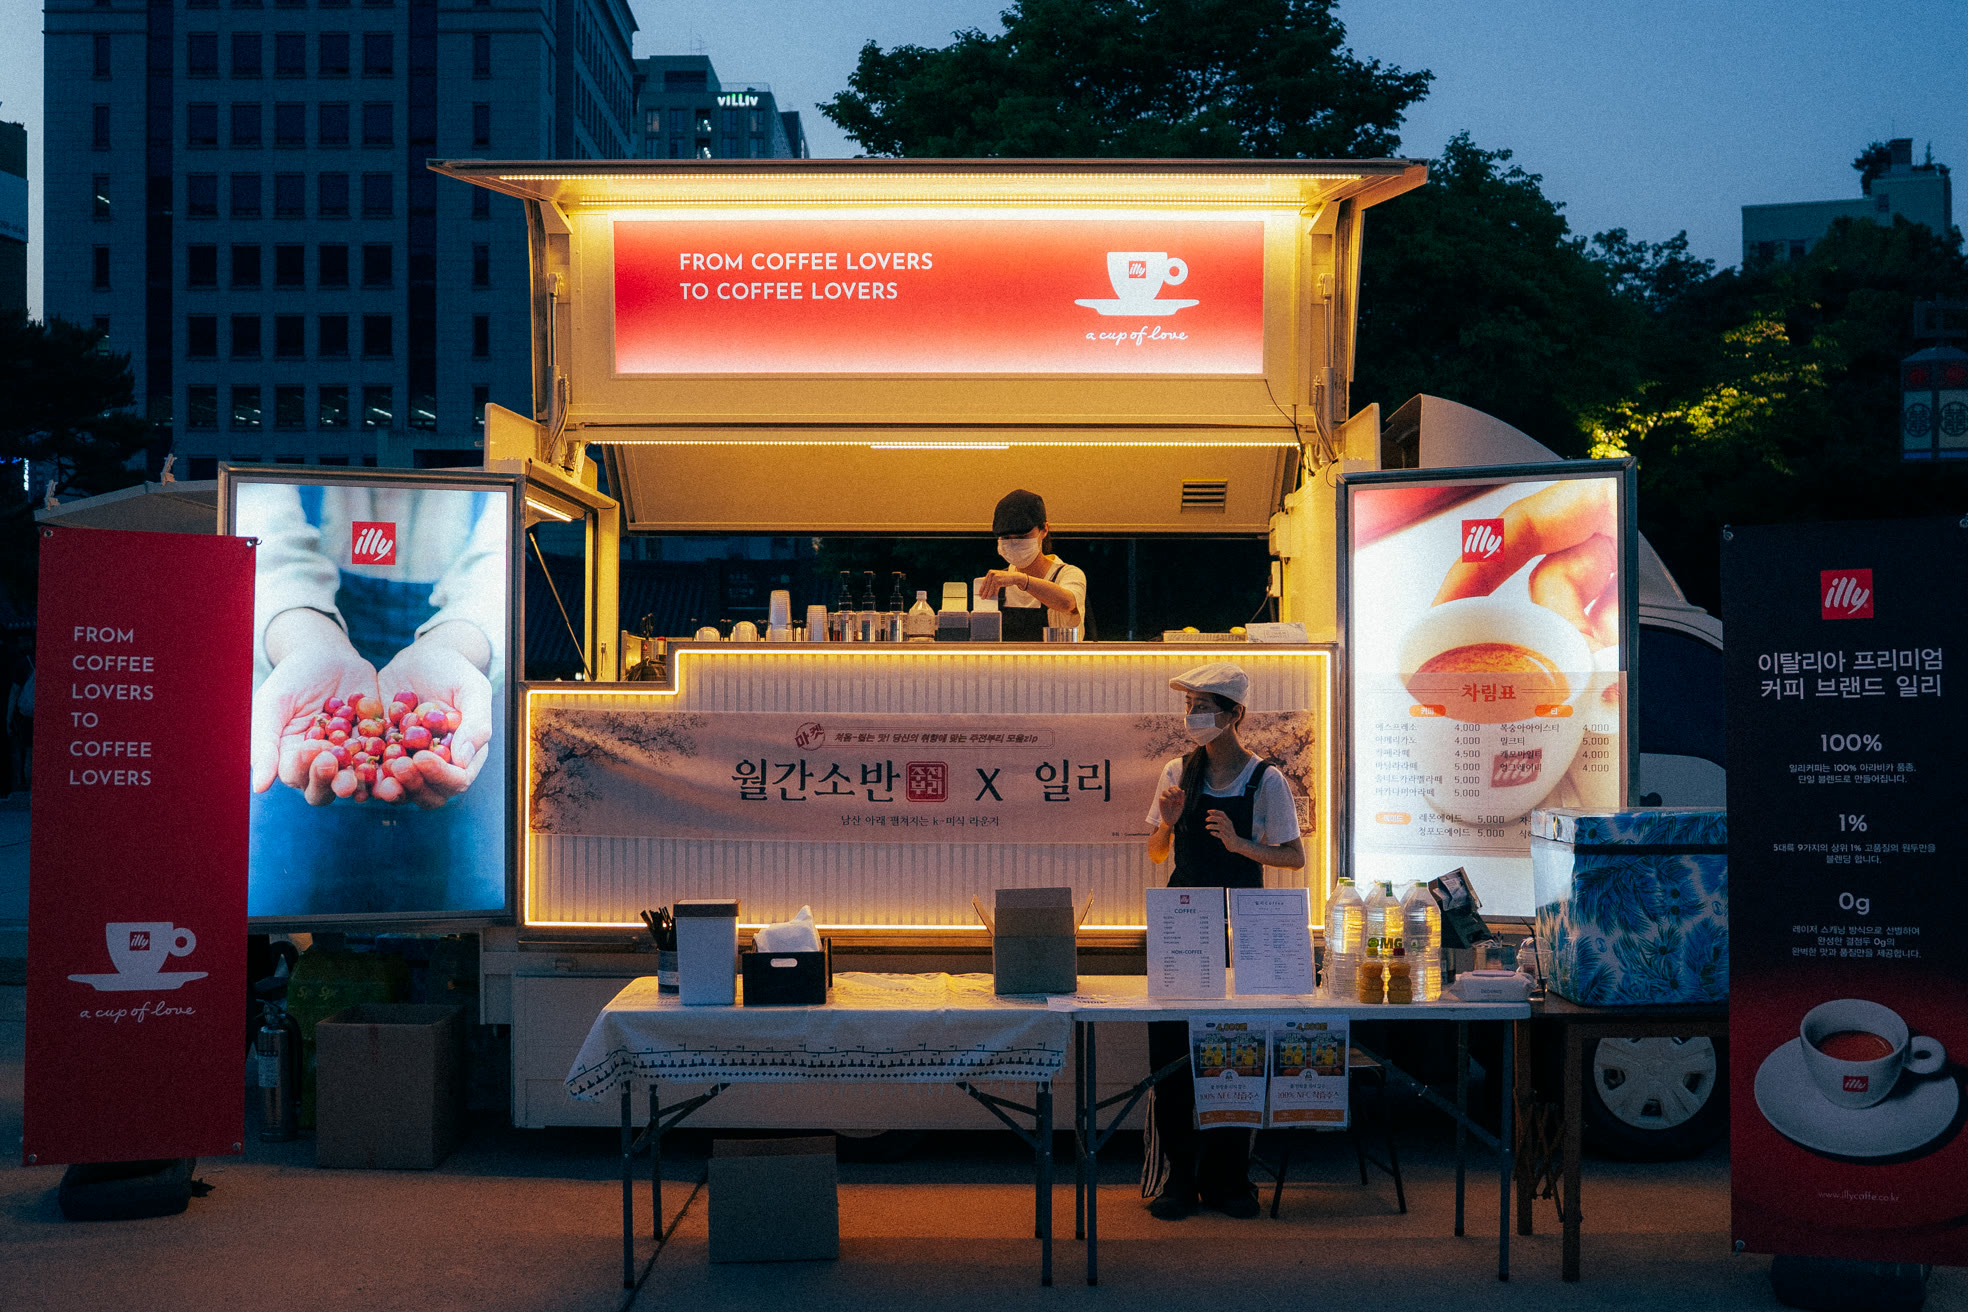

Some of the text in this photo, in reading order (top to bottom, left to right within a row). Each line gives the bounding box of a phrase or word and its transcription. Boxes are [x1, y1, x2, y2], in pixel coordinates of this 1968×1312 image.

[680, 252, 933, 270] FROM COFFEE LOVERS
[1129, 262, 1146, 278] illy
[680, 282, 898, 300] TO COFFEE LOVERS
[1086, 326, 1188, 346] a cup of love
[354, 527, 394, 562] illy
[1464, 525, 1502, 559] illy
[1824, 576, 1870, 615] illy
[74, 626, 134, 643] FROM
[72, 655, 154, 672] COFFEE
[1758, 647, 1942, 674] 이탈리아 프리미엄
[72, 683, 154, 701] LOVERS
[1461, 683, 1517, 702] 차림표
[1761, 674, 1941, 700] 커피 브랜드 일리
[71, 712, 99, 728] TO
[1375, 722, 1480, 732] 에스프레소 4,000
[794, 723, 825, 748] 마켓
[1500, 724, 1610, 733] 복숭아아이스티 4,000
[892, 733, 919, 744] 당신의
[969, 734, 1004, 744] 주전부리
[1454, 736, 1480, 745] 4,000
[1500, 736, 1610, 746] 밀크티 5,000
[1820, 733, 1883, 752] 100%
[70, 741, 152, 758] COFFEE
[1454, 750, 1480, 758] 4,500
[1582, 750, 1610, 760] 4,000
[1454, 762, 1480, 772] 5,000
[1582, 764, 1610, 772] 4,000
[1788, 764, 1831, 774] 일리커피는
[1834, 764, 1857, 773] 100%
[1860, 763, 1894, 773] 아라비카
[69, 769, 152, 786] LOVERS
[731, 758, 902, 803] 월간소반
[974, 768, 1004, 802] X
[1035, 759, 1111, 803] 일리
[1454, 776, 1480, 784] 5,000
[1798, 774, 1908, 784] 단일 블렌드로 만들어집니다.
[1454, 788, 1480, 798] 5,000
[841, 815, 1000, 827] 남산 아래 펼쳐지는 k-미식 라운지
[1418, 813, 1464, 824] 레몬에이드
[1477, 815, 1504, 825] 5,000
[1838, 814, 1868, 832] 1%
[1419, 827, 1471, 838] 청포도에이드
[1477, 828, 1504, 838] 5,000
[1797, 843, 1828, 852] 9가지의
[1831, 844, 1849, 853] 상위
[1850, 844, 1862, 852] 1%
[1864, 844, 1899, 853] 고품질의
[1902, 843, 1936, 853] 원두만을
[1826, 855, 1882, 864] 블렌딩 합니다.
[1838, 892, 1870, 916] 0g
[1792, 925, 1818, 934] 레이저
[1848, 926, 1883, 935] 방식으로
[131, 934, 149, 950] illy
[1873, 937, 1896, 948] 0g의
[1820, 948, 1837, 957] 맛과
[80, 1000, 196, 1024] a cup of love
